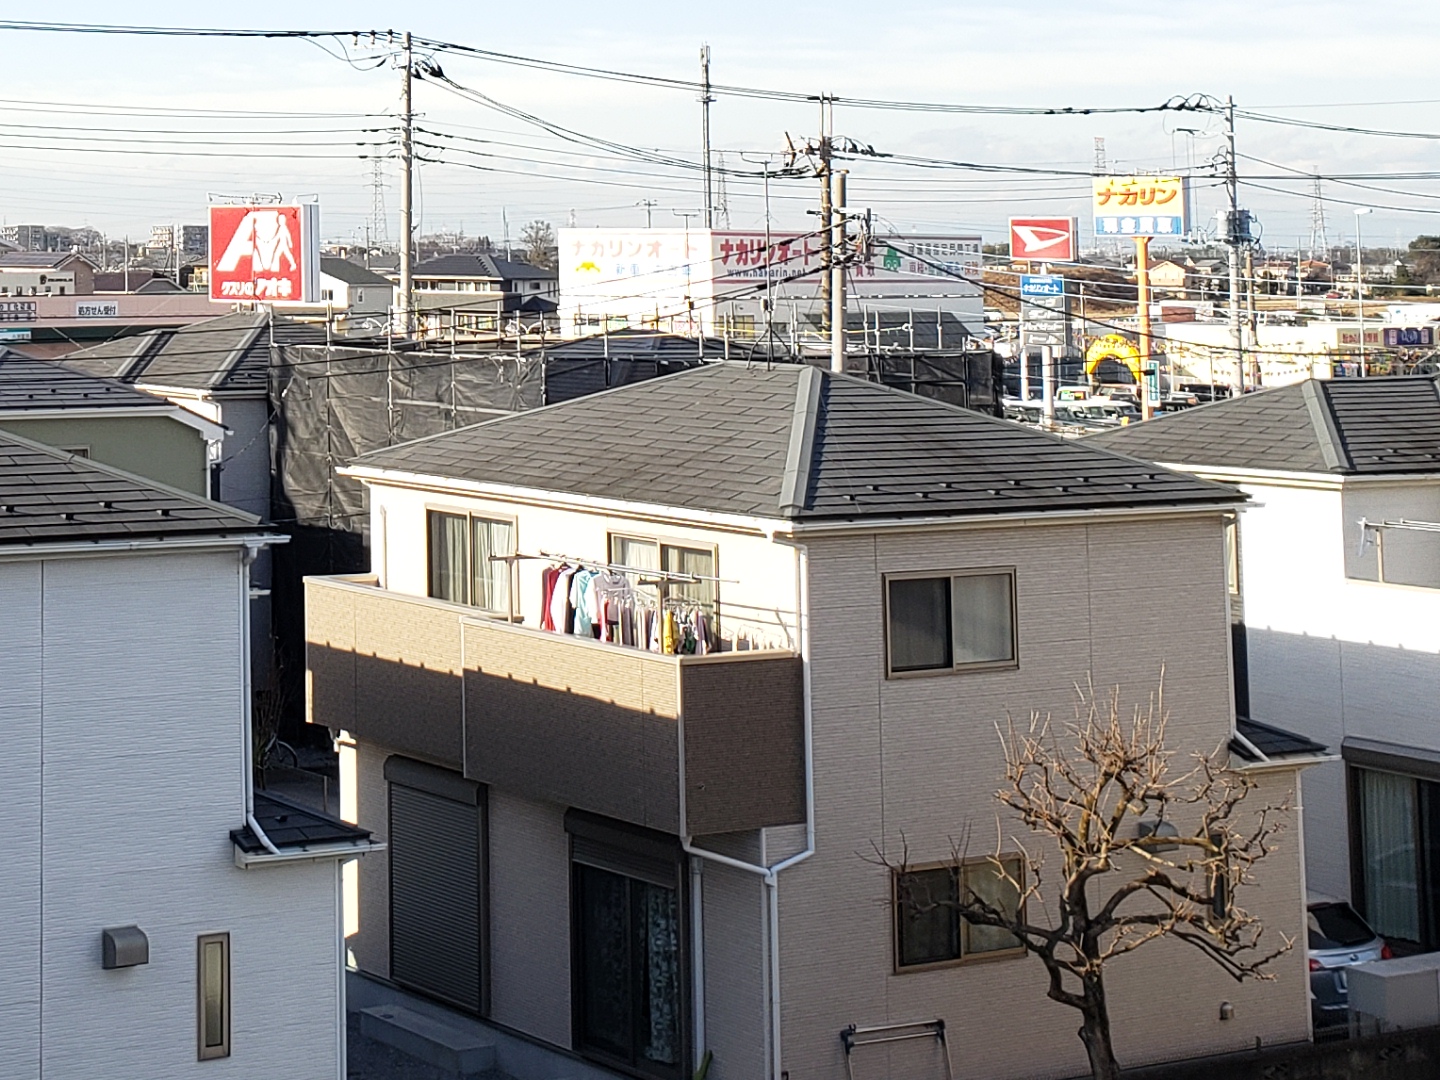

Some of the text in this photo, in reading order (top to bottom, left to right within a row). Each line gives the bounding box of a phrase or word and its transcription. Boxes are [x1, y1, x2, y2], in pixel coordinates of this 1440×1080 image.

[1097, 187, 1177, 206] ナカリン
[720, 238, 815, 266] ナカリンオート
[221, 278, 292, 297] クスリのアオキ
